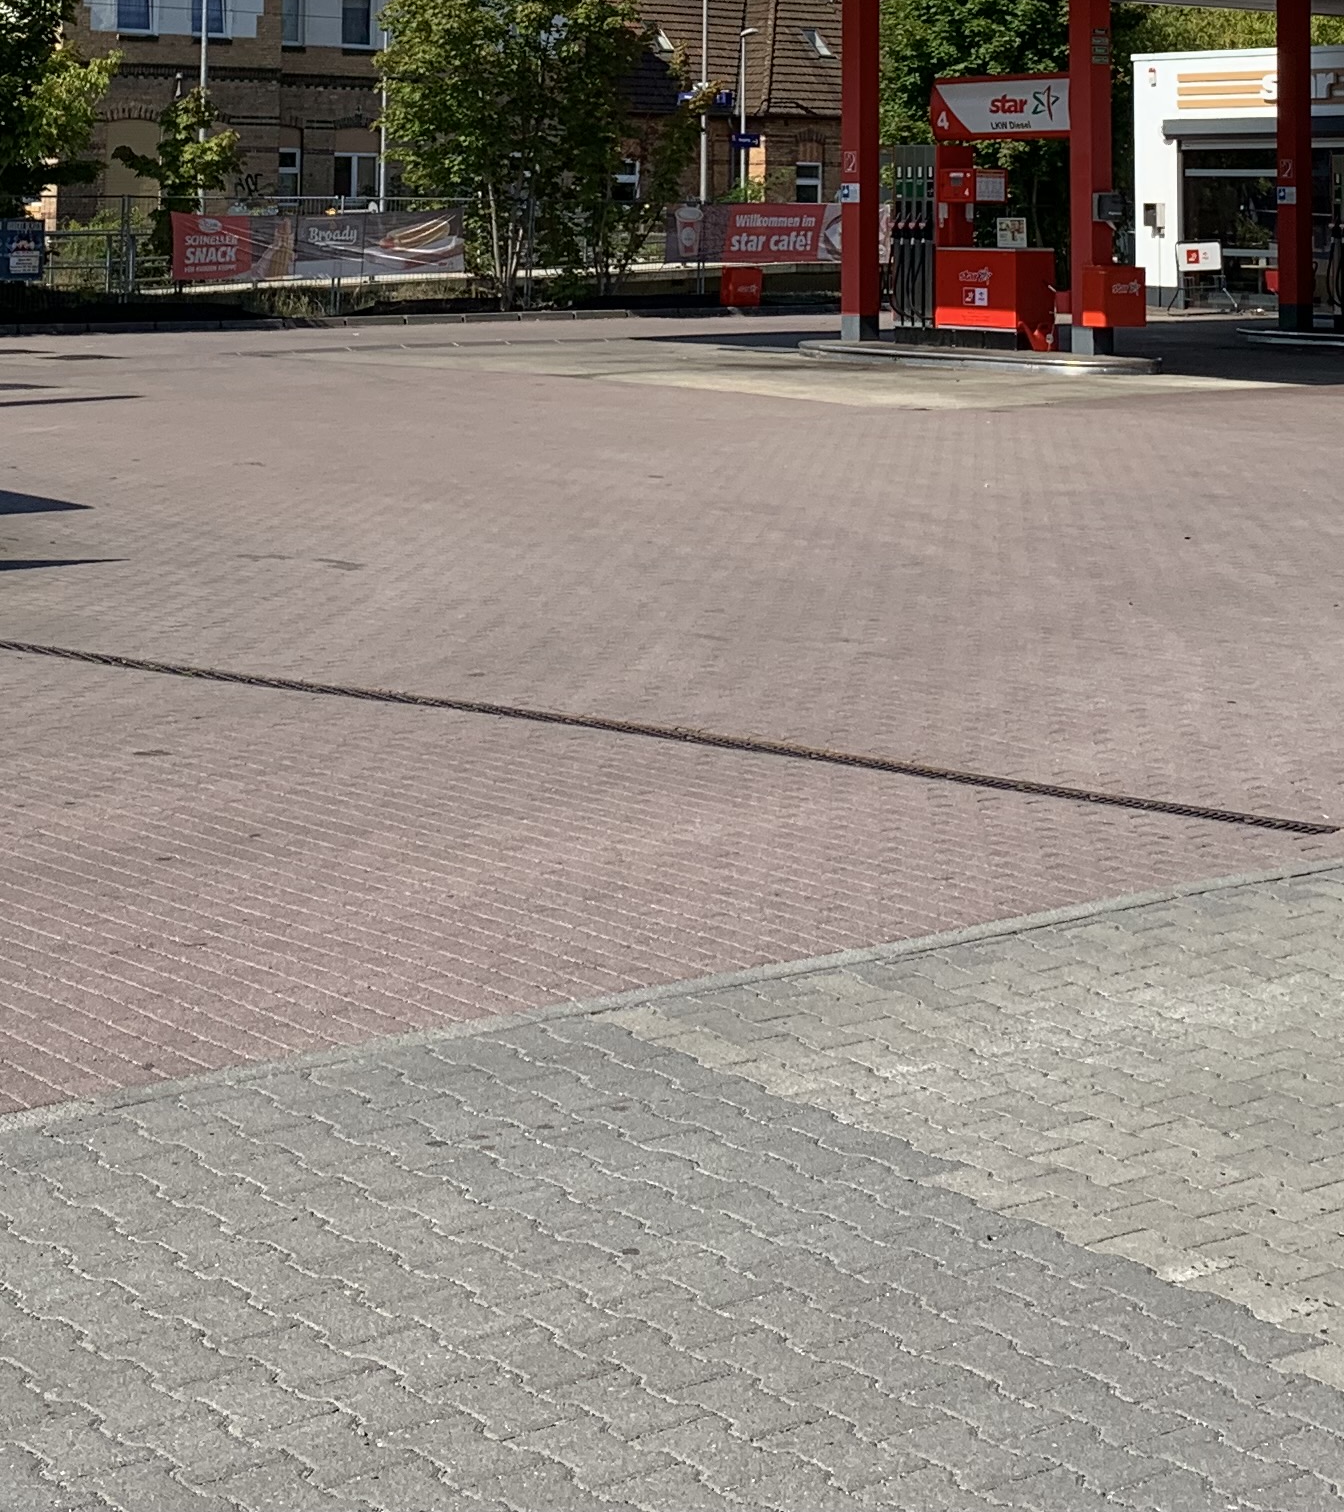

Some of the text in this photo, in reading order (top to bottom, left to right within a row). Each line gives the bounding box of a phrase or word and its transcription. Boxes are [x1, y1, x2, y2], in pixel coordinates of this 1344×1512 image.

[989, 94, 1027, 114] star
[937, 111, 949, 130] 4
[991, 120, 1032, 130] LKW Diesel
[736, 214, 816, 228] Willkommen im
[184, 235, 238, 245] SCHNELLER
[308, 225, 357, 245] Broady
[730, 231, 814, 252] star café!
[184, 246, 239, 264] SNACK
